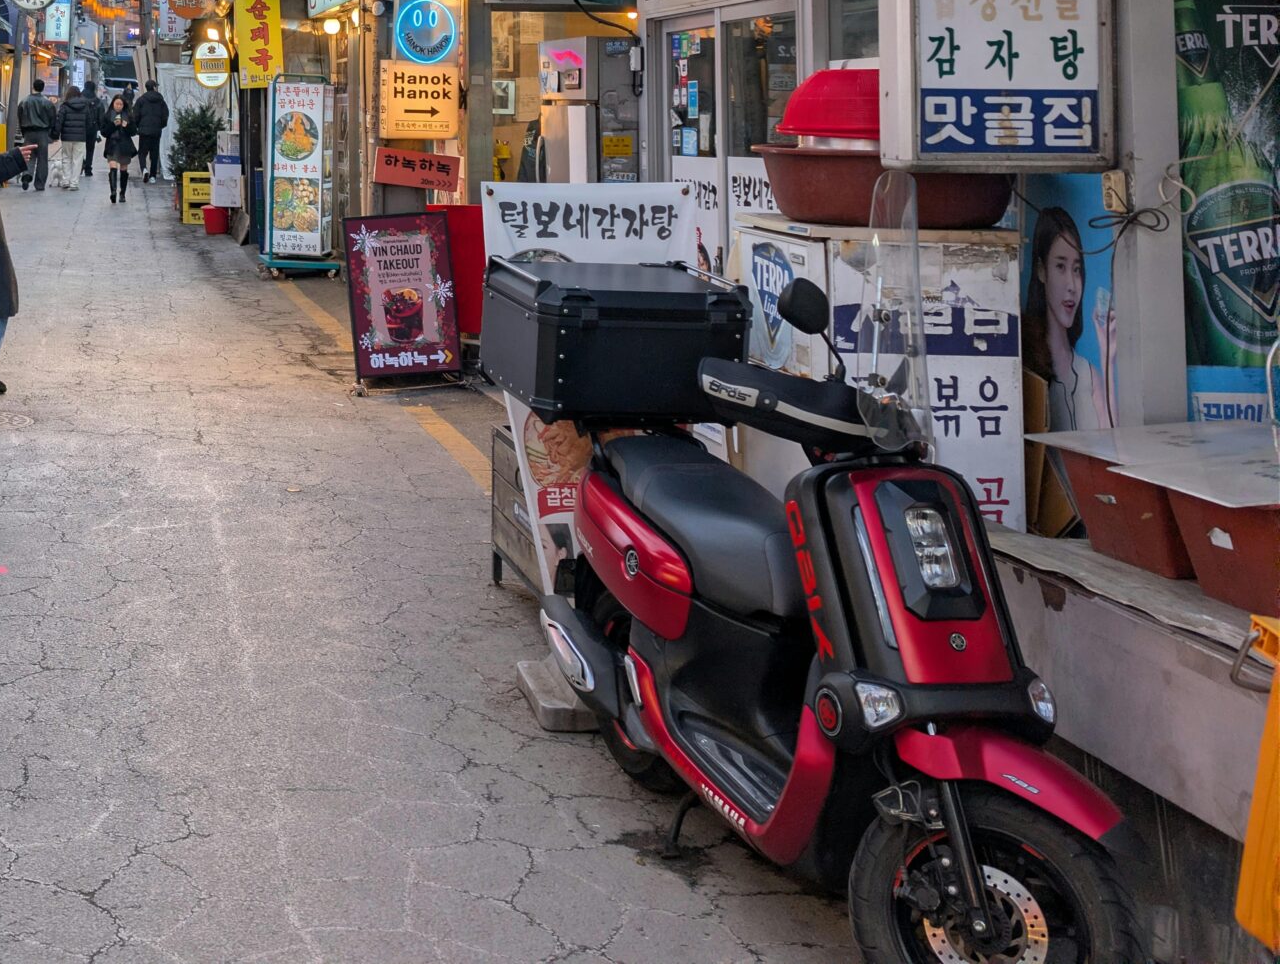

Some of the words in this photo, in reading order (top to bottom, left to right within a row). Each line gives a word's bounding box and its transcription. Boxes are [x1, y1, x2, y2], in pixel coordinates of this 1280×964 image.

[393, 71, 452, 86] Hanok
[393, 86, 452, 100] Hanok
[384, 153, 452, 177] 하녹하녹
[498, 200, 679, 241] 털보네감자탕
[372, 246, 388, 257] VIN
[390, 244, 422, 255] CHAUD
[1198, 226, 1280, 275] TERR
[376, 258, 420, 271] TAKEOUT
[370, 351, 428, 369] 하녹하녹
